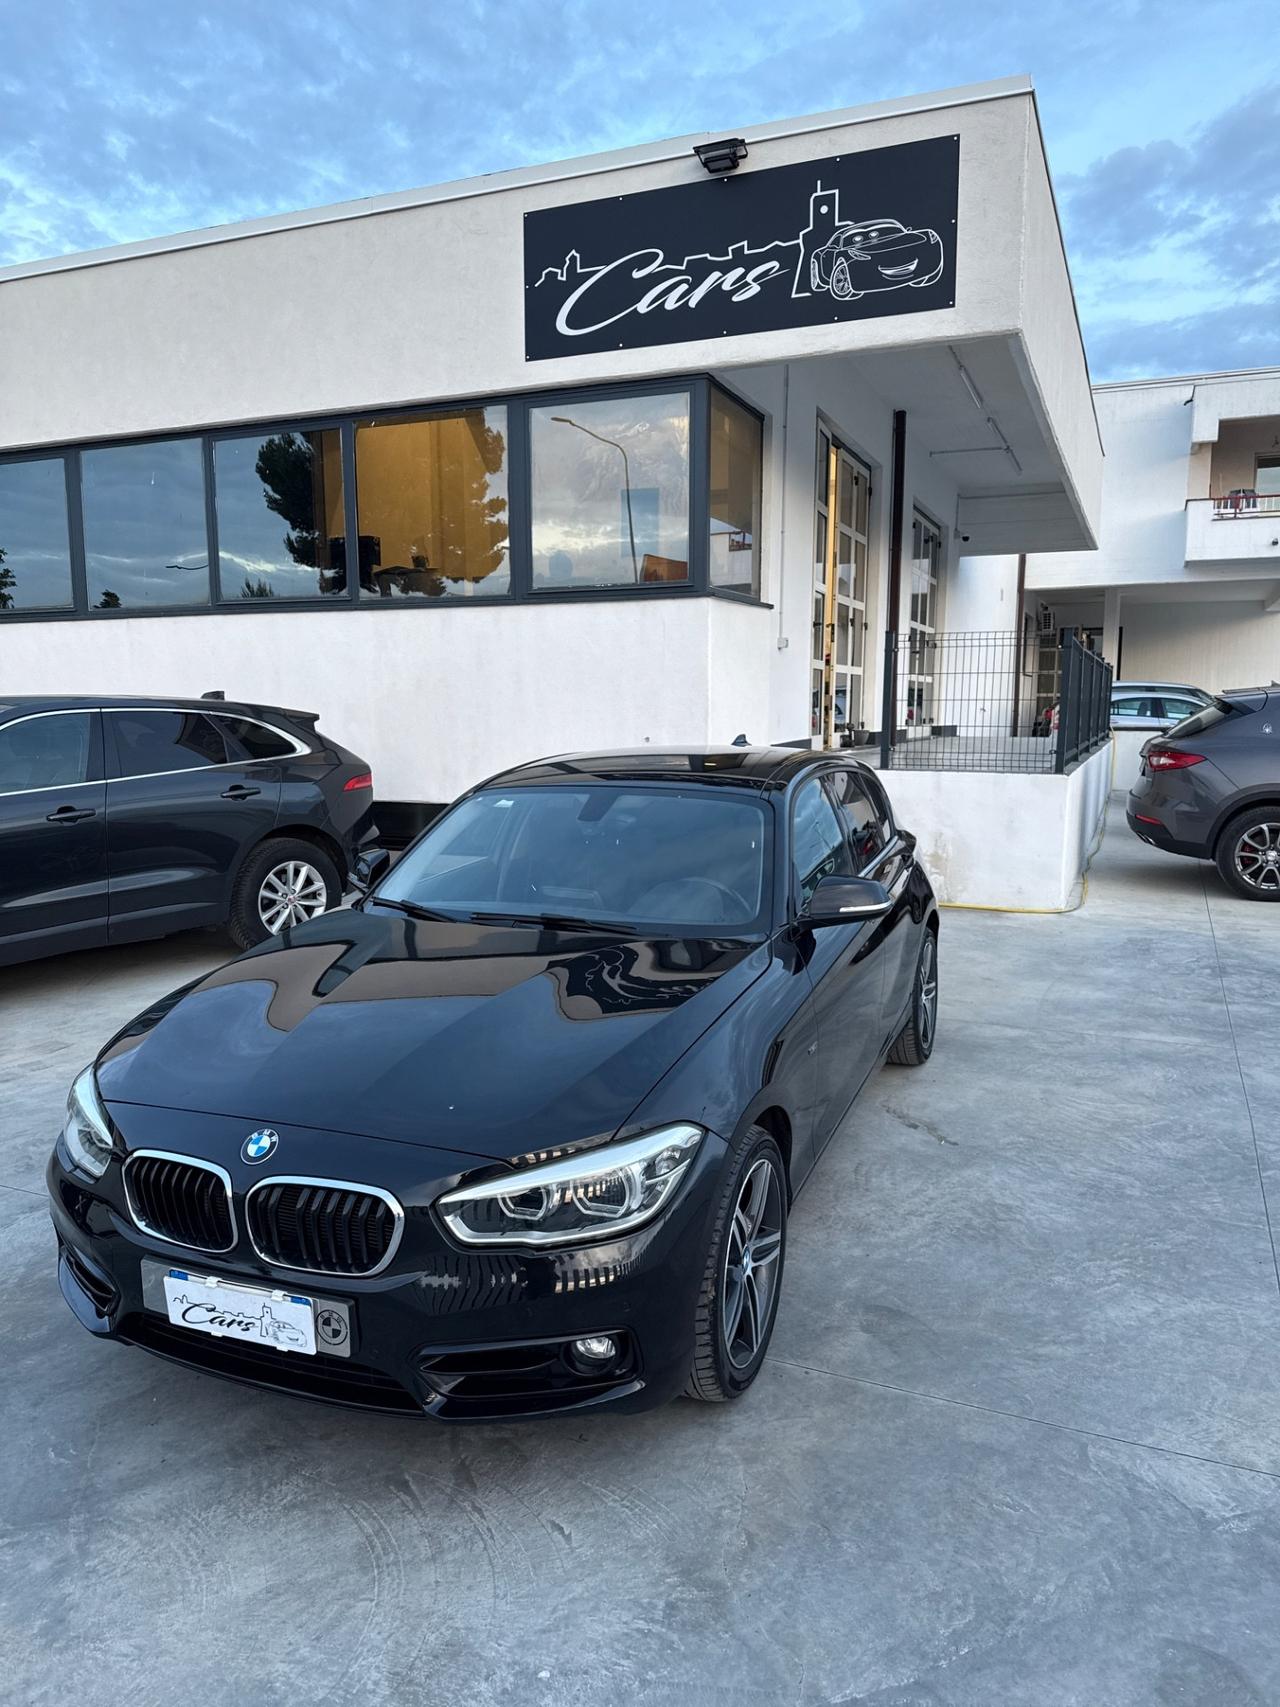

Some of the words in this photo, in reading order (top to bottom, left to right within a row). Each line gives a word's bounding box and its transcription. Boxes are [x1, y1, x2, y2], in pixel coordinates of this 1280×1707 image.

[555, 248, 790, 336] Cars
[251, 1129, 278, 1143] BMW
[181, 1302, 257, 1332] Cars
